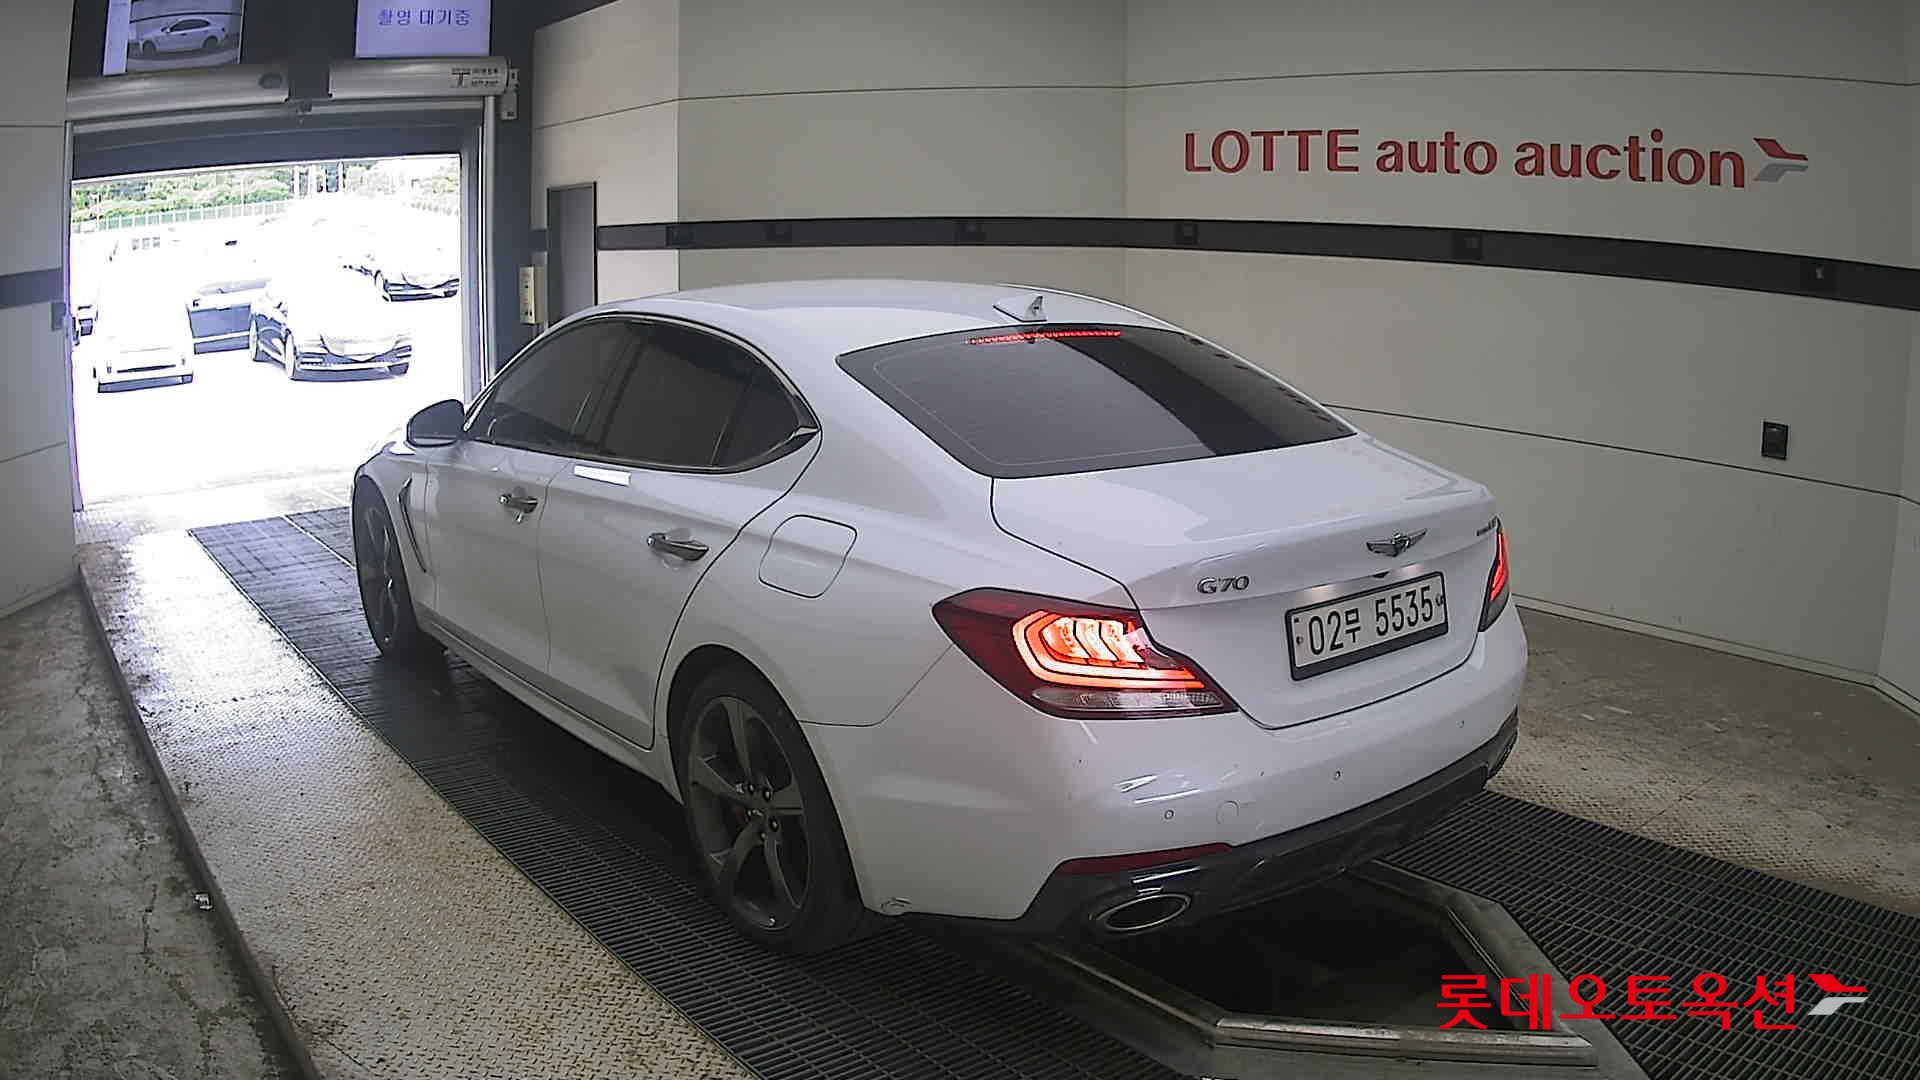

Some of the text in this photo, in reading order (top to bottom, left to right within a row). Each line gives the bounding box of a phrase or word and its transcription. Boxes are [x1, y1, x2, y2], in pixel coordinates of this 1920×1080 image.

[419, 9, 471, 26] 대기중
[1184, 128, 1746, 188] LOTTE auto auction
[1196, 576, 1250, 594] G70
[1308, 585, 1433, 655] 02무 5535
